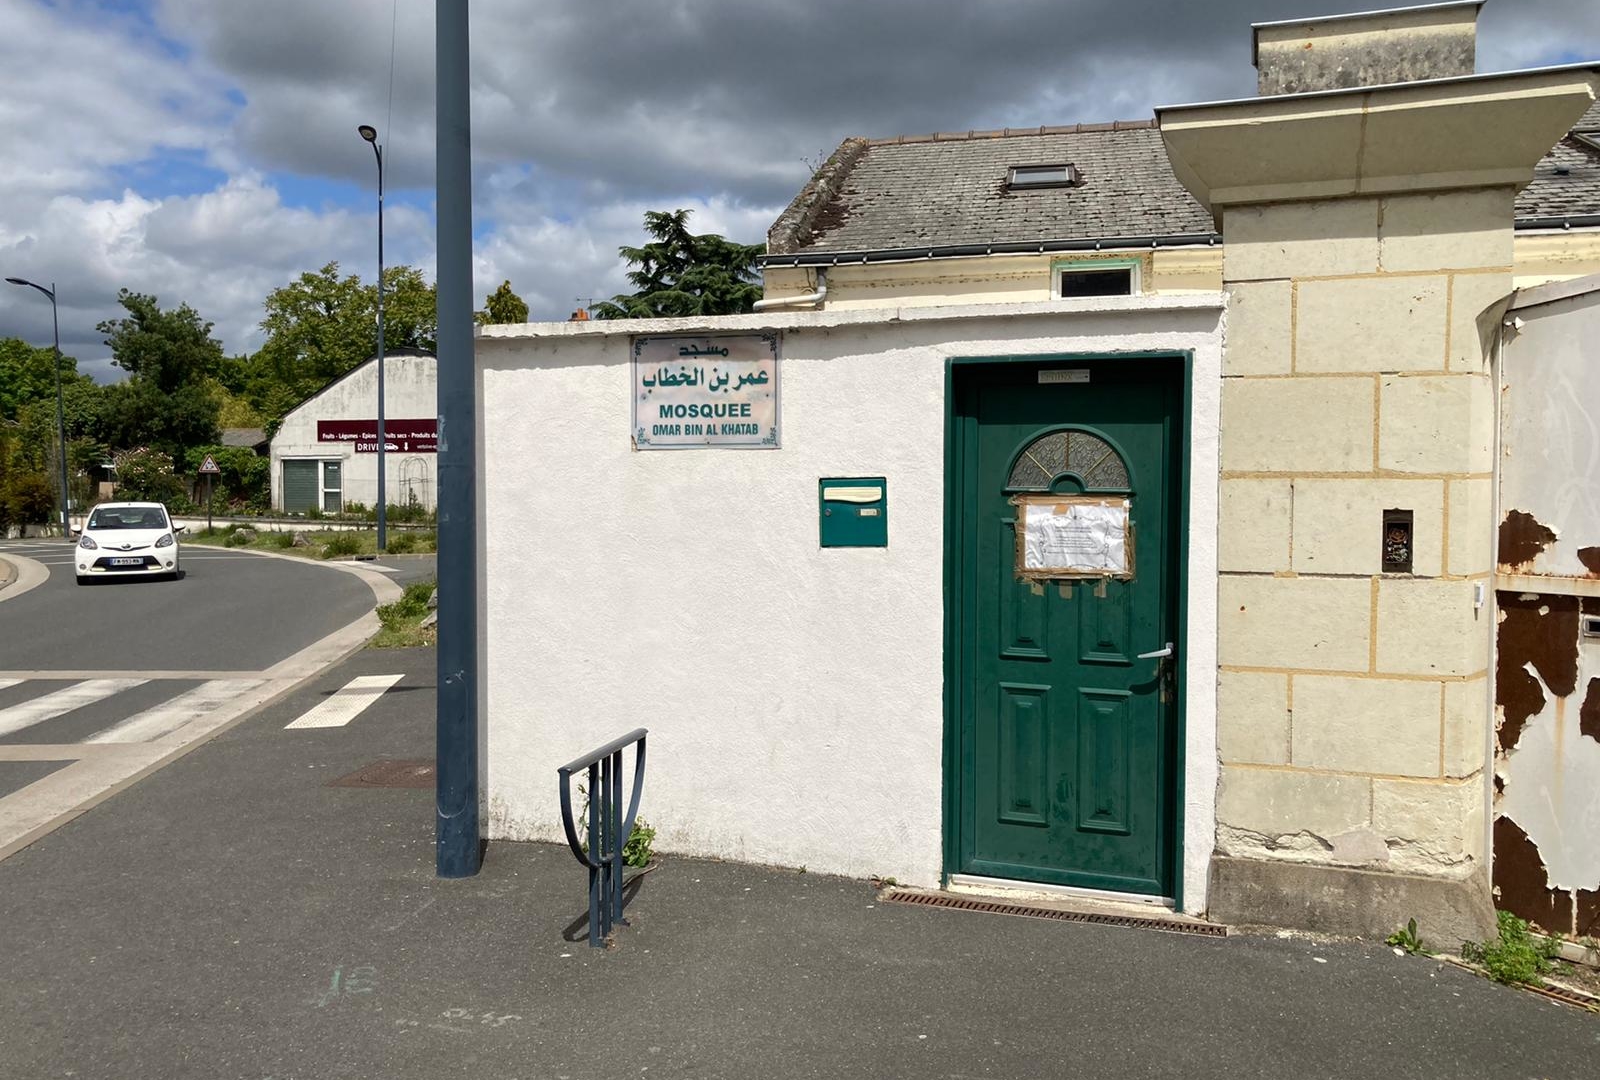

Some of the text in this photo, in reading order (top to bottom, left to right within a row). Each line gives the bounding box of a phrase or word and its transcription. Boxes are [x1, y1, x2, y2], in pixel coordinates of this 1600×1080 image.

[679, 344, 729, 359] مسجد
[642, 366, 769, 394] عمر بن الخطاب
[660, 404, 751, 418] MOSQUEE
[652, 423, 759, 436] OMAR BIN AL KHATAB
